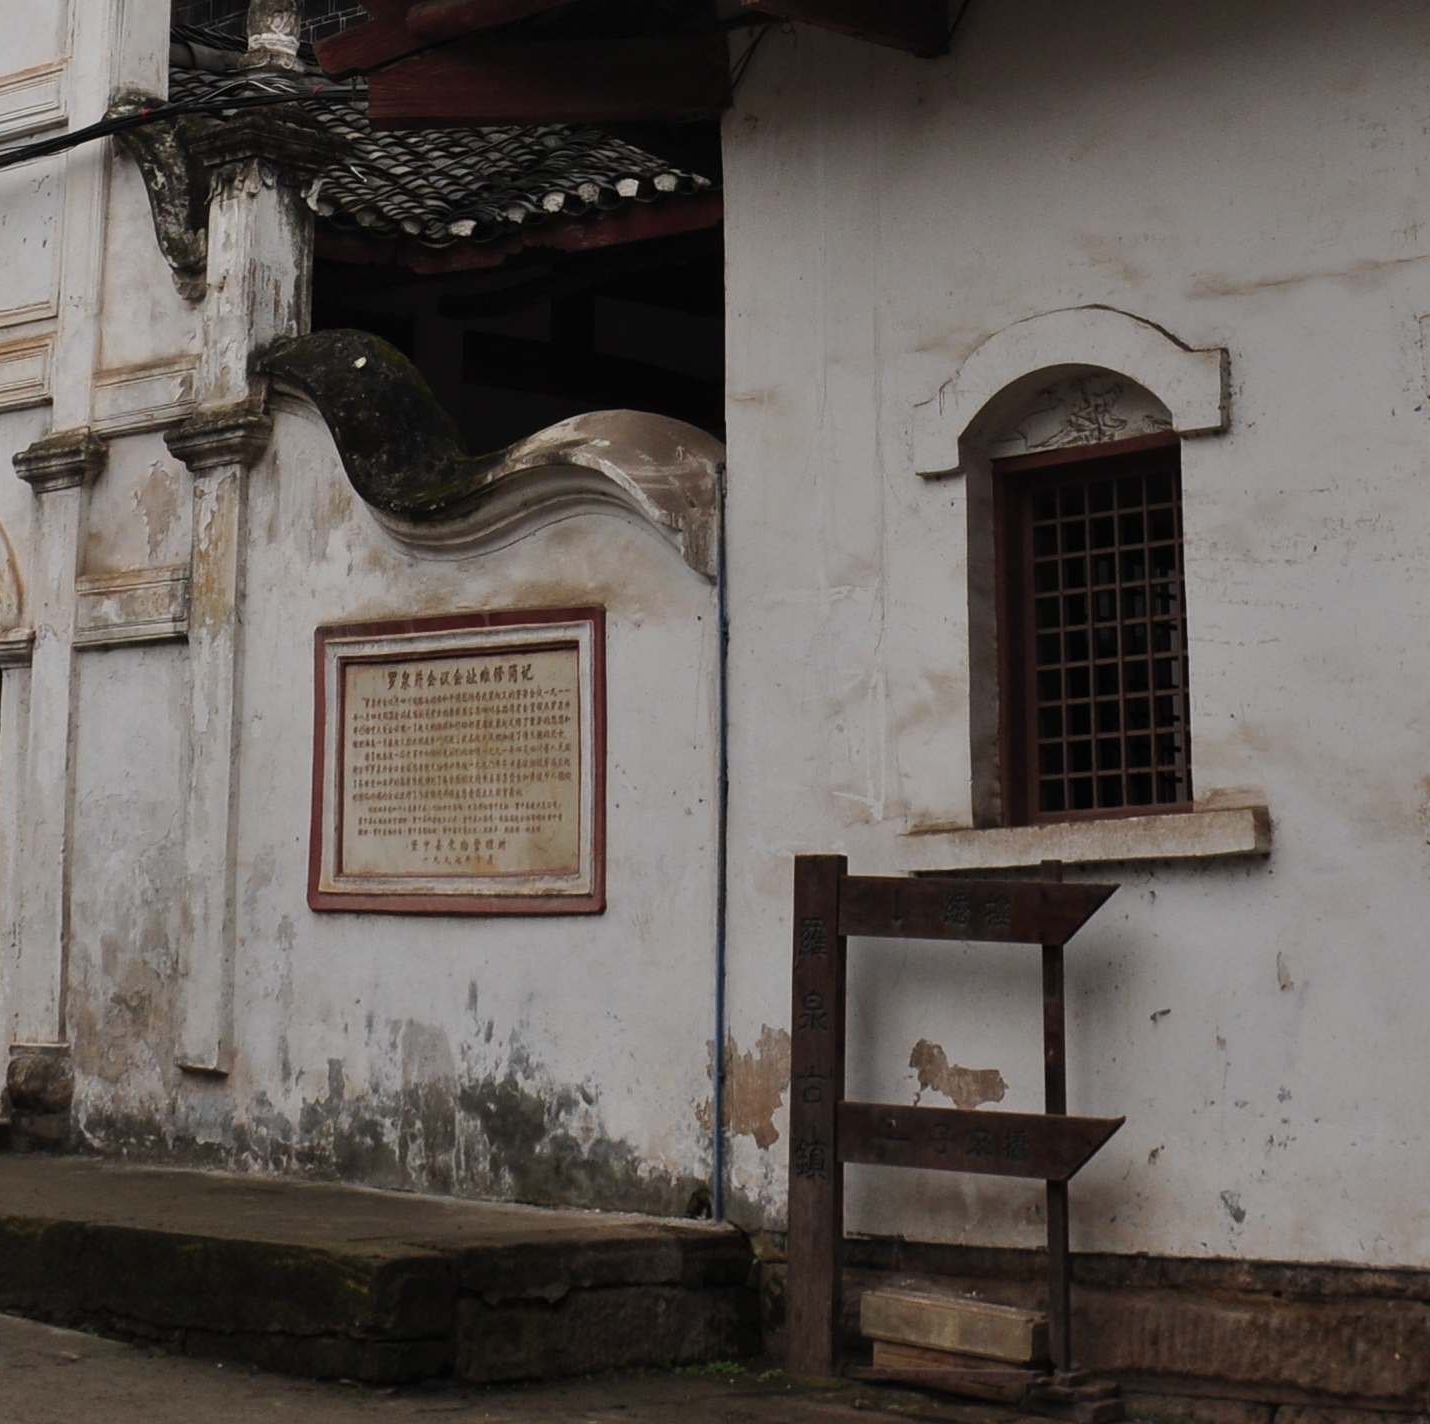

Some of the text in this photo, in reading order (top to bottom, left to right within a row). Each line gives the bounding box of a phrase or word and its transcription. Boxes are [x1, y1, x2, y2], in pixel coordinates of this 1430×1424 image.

[796, 917, 828, 1179] 羅泉古鎮
[929, 1124, 1030, 1162] 子來橋
